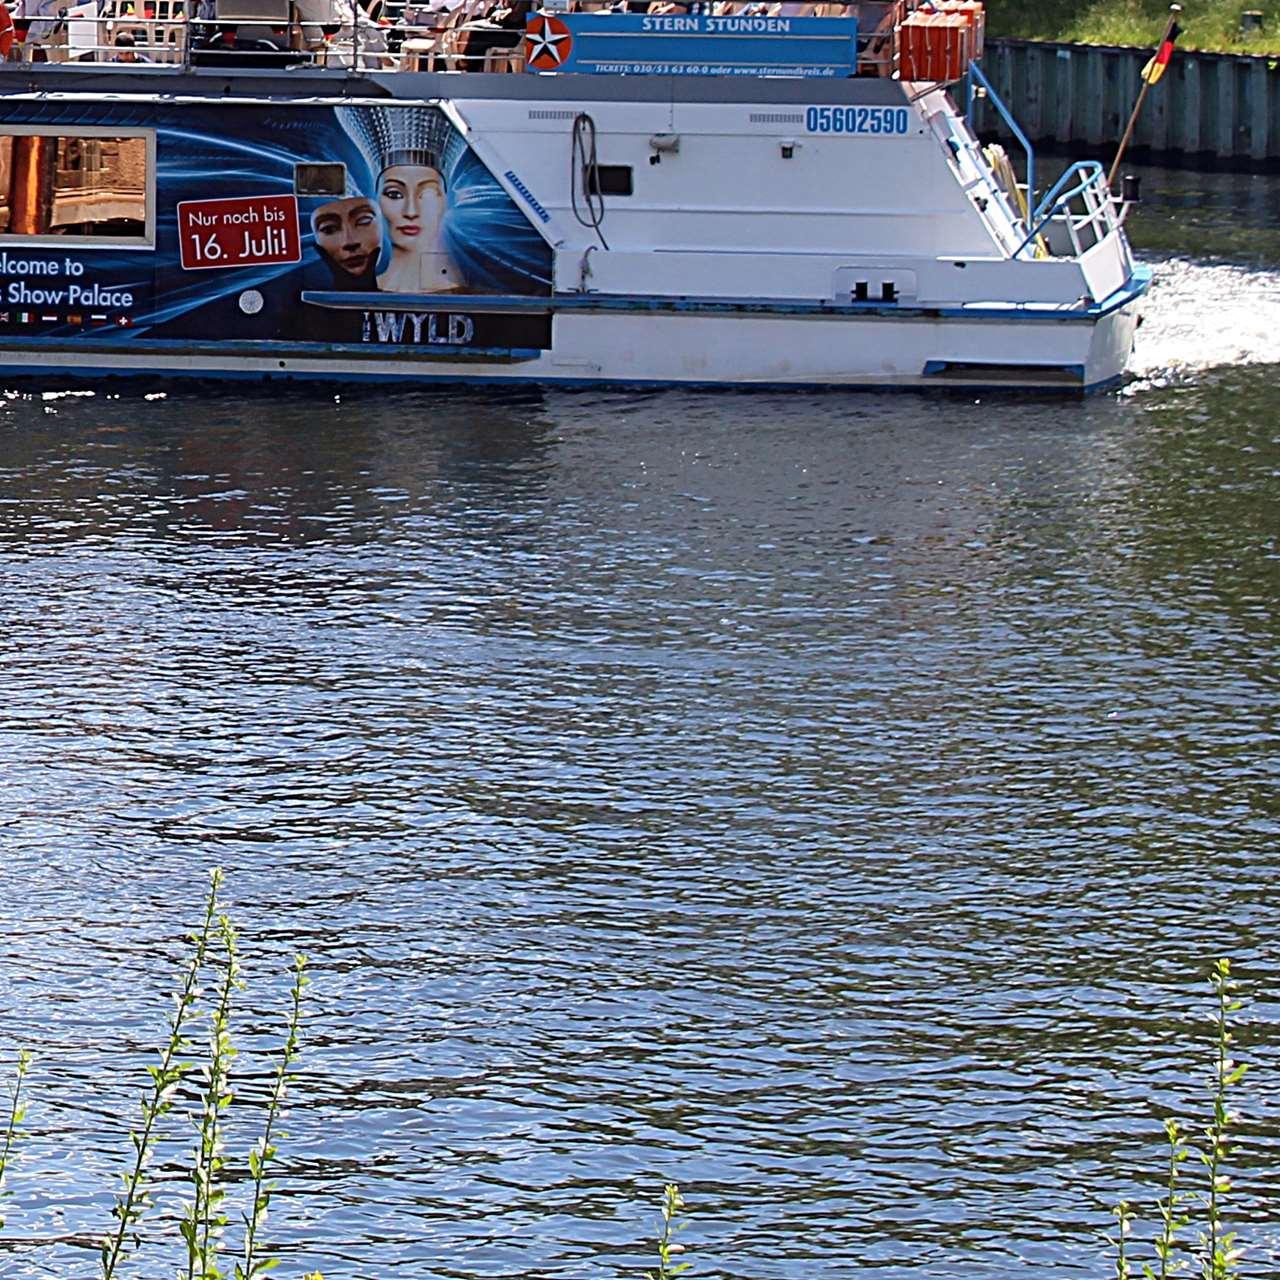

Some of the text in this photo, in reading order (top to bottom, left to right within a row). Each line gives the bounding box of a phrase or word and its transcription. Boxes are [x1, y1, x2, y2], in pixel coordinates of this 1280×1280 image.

[642, 17, 790, 33] STERN STUNDEN
[806, 106, 908, 134] 05602590
[189, 205, 285, 227] Nur noch bis
[191, 225, 287, 260] 16. Juli!
[64, 258, 84, 276] to
[374, 312, 474, 344] WYLD
